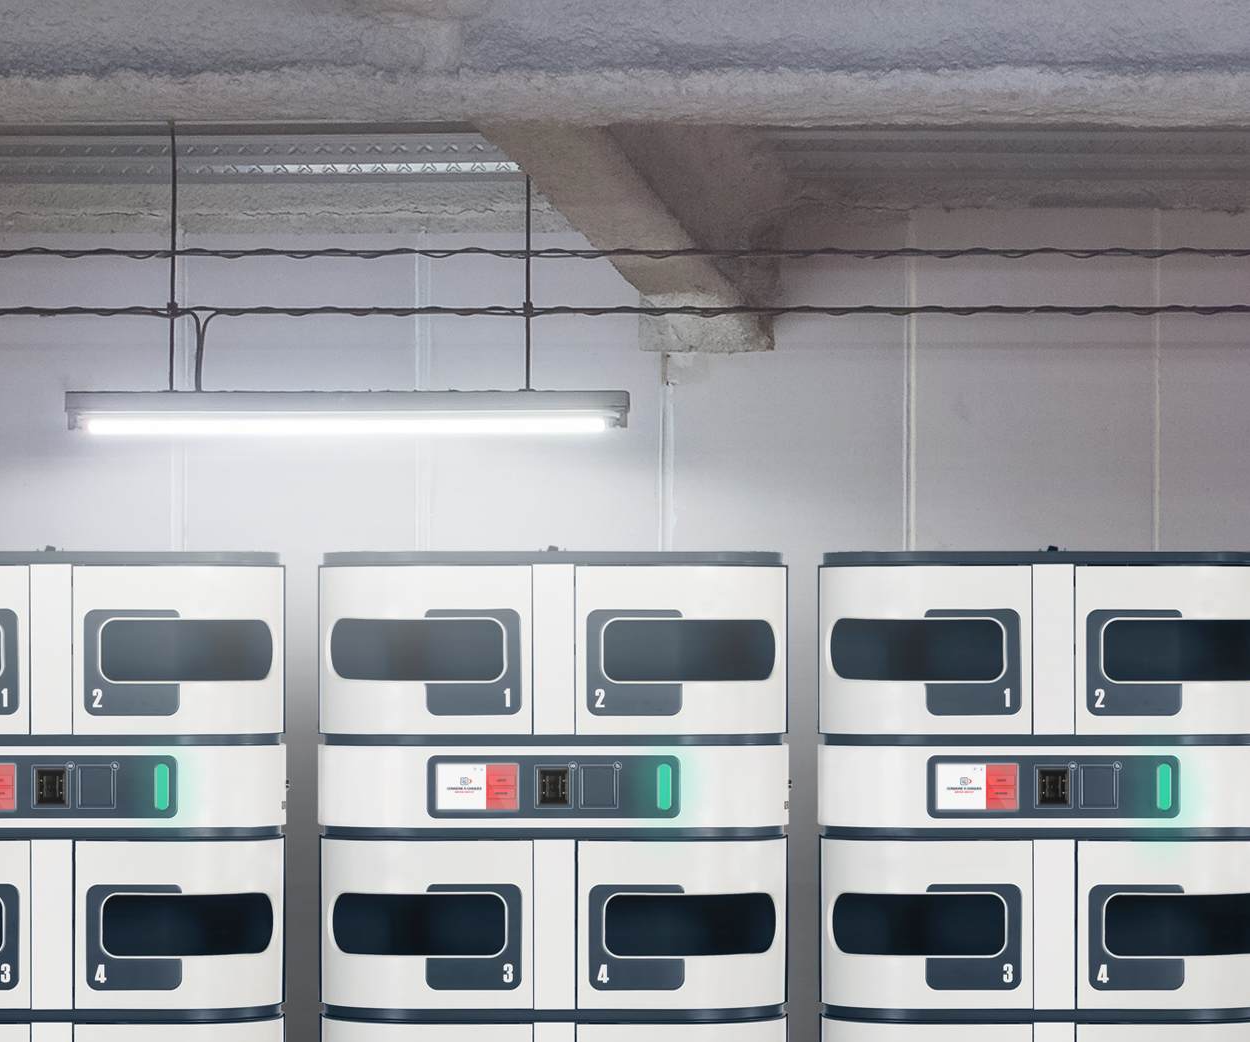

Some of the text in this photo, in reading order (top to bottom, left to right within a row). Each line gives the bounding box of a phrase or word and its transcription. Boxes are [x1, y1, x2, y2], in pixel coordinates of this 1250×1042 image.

[1, 688, 8, 708] 1
[92, 688, 103, 708] 2
[504, 688, 511, 708] 1
[595, 688, 606, 708] 2
[1004, 688, 1011, 708] 1
[1095, 688, 1106, 708] 2
[0, 964, 11, 983] 3
[94, 964, 107, 984] 4
[503, 964, 514, 983] 3
[597, 964, 610, 984] 4
[1003, 964, 1014, 983] 3
[1097, 964, 1110, 984] 4
